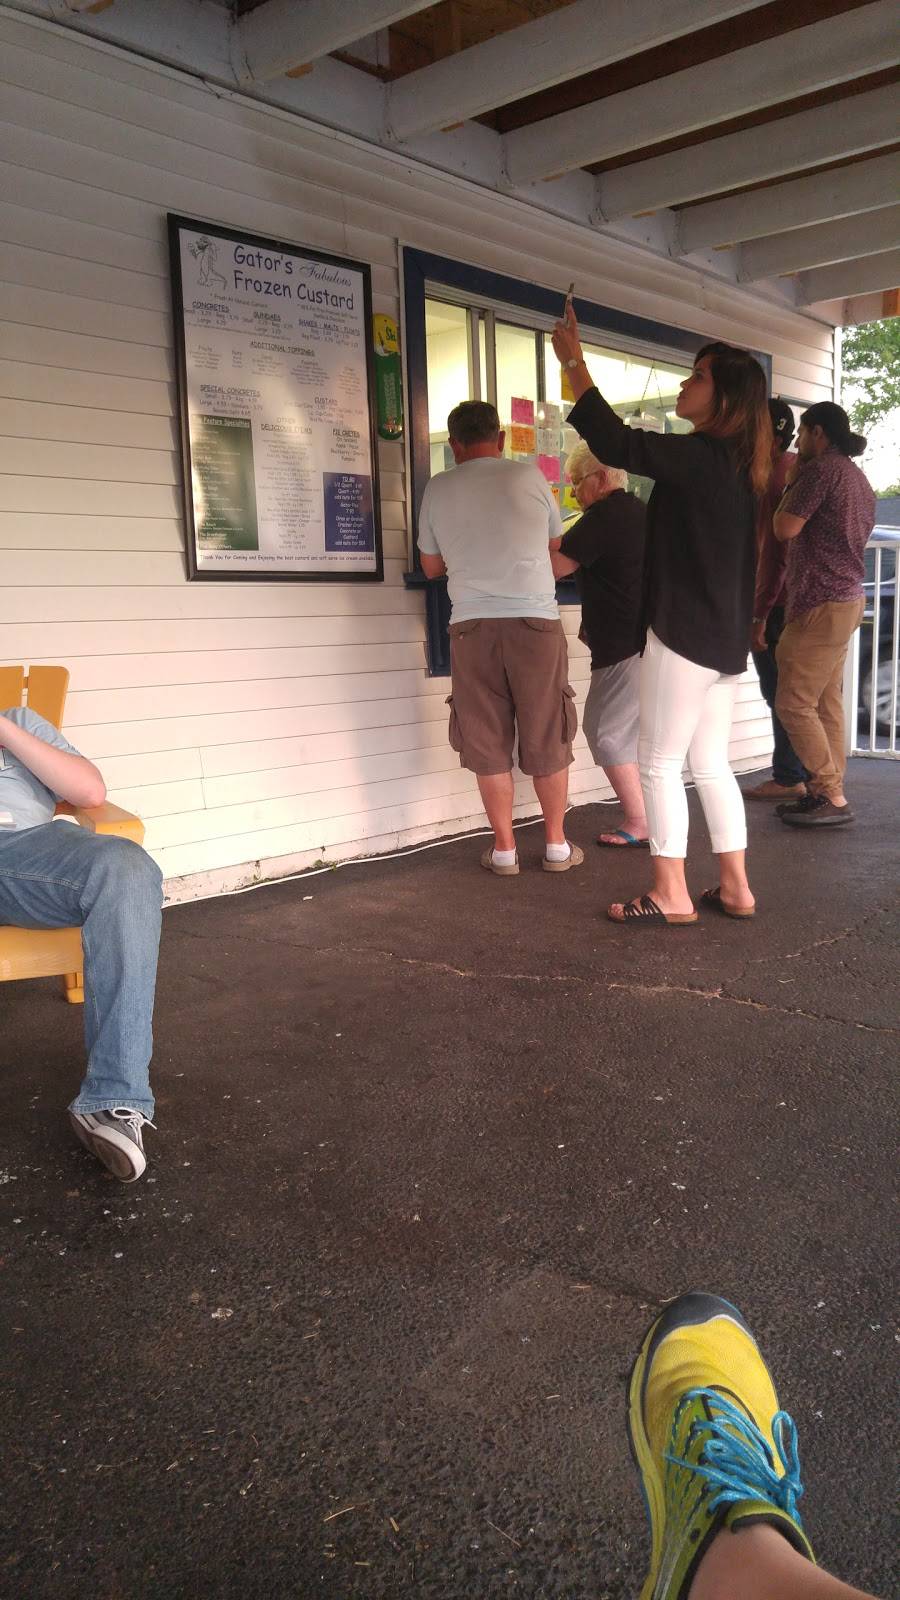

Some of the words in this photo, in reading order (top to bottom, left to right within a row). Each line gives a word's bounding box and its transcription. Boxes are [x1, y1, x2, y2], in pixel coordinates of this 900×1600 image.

[233, 245, 293, 275] Gator's
[300, 260, 352, 287] Fabulous
[233, 269, 292, 299] Frozen
[297, 283, 354, 310] Custard
[250, 340, 285, 354] ADDITIONAL
[200, 384, 225, 394] SPECIAL
[776, 417, 787, 431] 3
